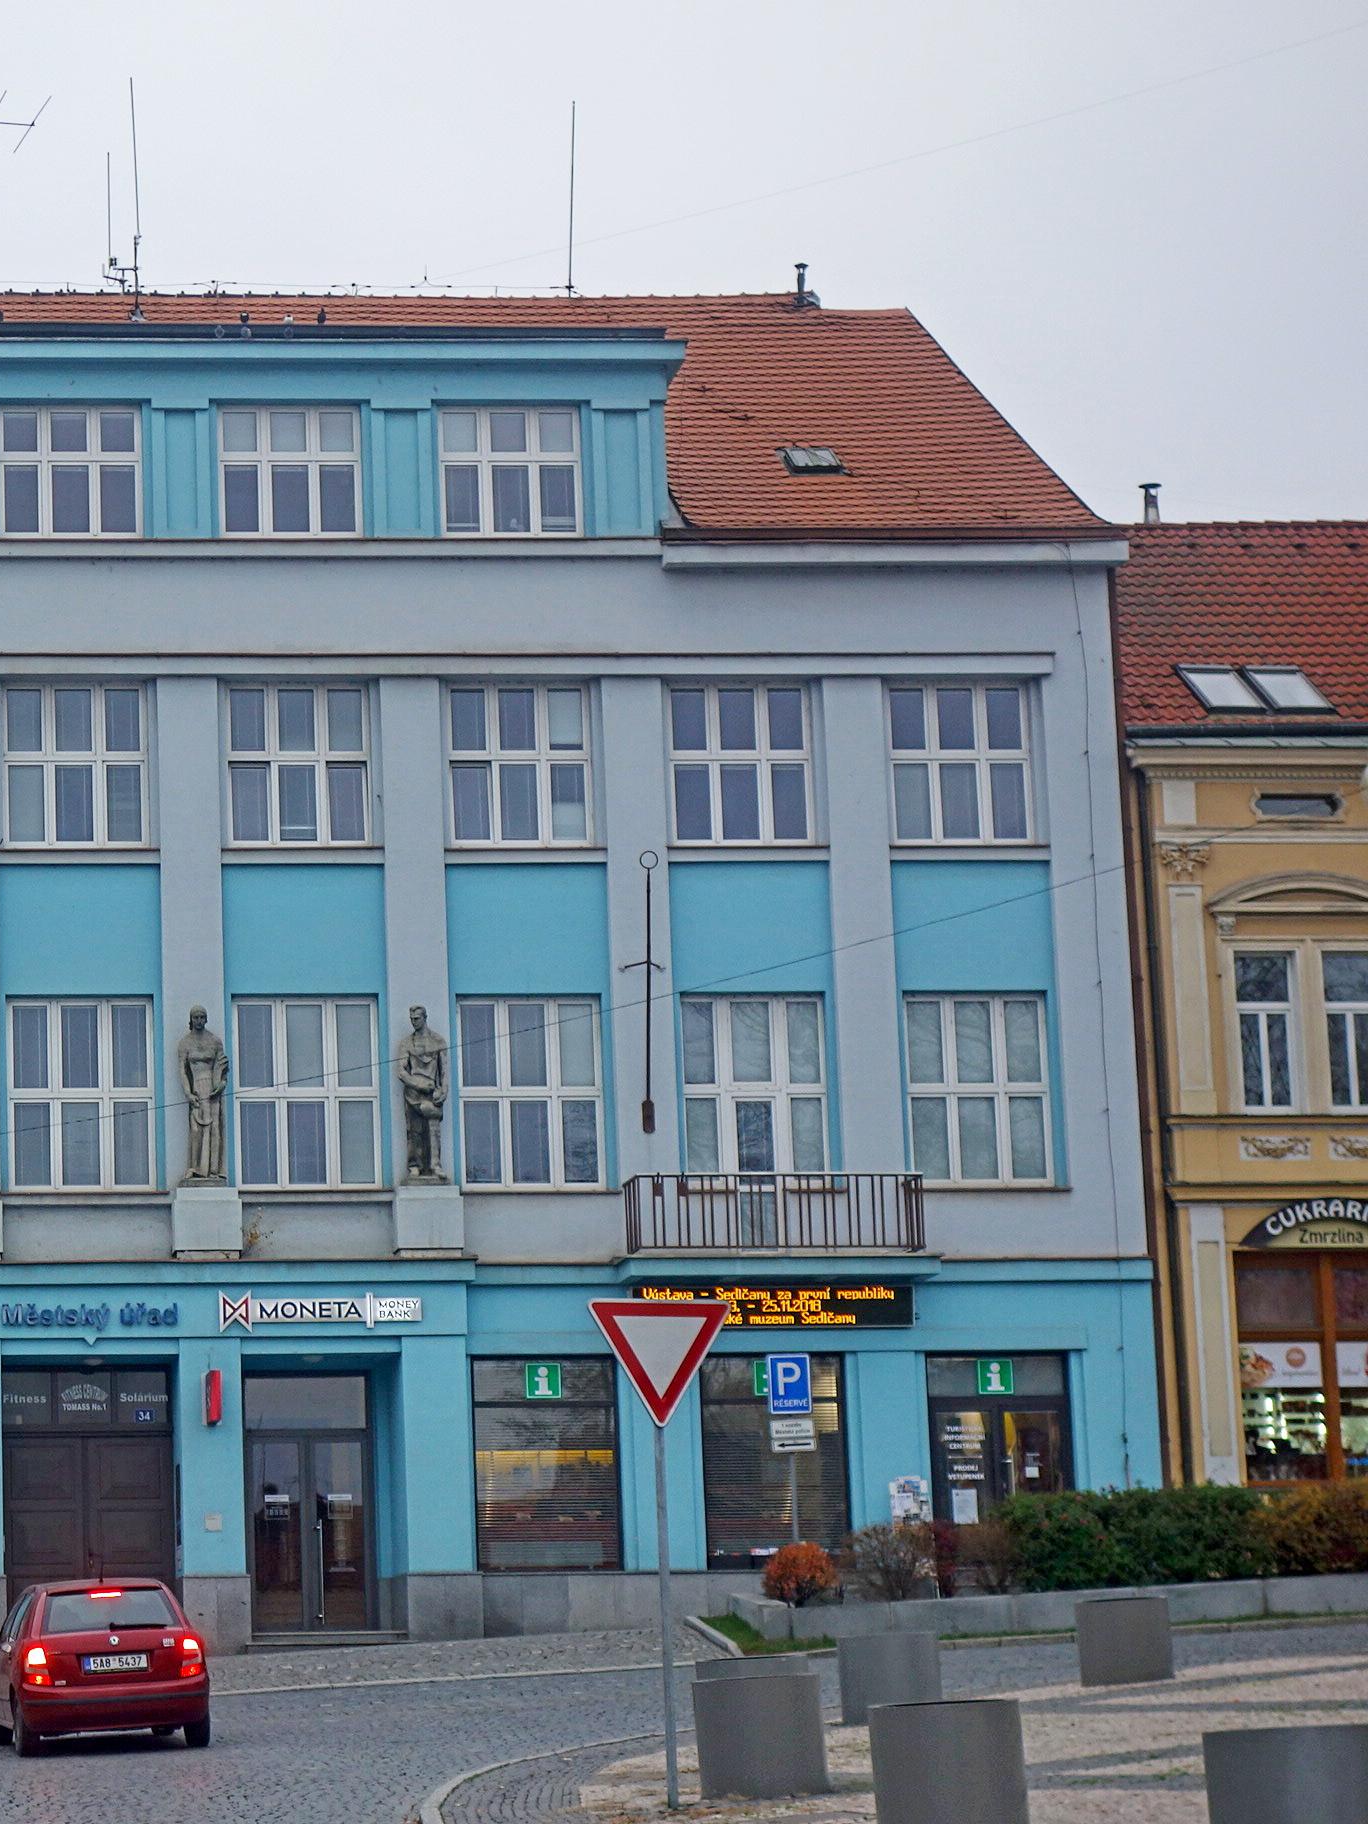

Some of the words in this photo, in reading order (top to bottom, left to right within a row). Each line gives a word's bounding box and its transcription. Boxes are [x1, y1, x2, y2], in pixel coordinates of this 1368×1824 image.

[1298, 1228, 1364, 1244] Zmrzlina
[777, 1290, 792, 1300] za
[799, 1287, 830, 1300] první
[837, 1286, 895, 1300] republiky
[259, 1301, 362, 1319] MONETA
[378, 1300, 419, 1309] MONEY
[1, 1303, 110, 1331] Městský
[119, 1302, 178, 1327] úřad
[378, 1310, 411, 1319] BANK
[750, 1315, 795, 1324] muzeum
[777, 1362, 801, 1396] P
[3, 1393, 47, 1404] Fitness
[120, 1391, 168, 1403] Solárium
[63, 1403, 90, 1411] TOMASS
[138, 1411, 151, 1421] 34
[92, 1657, 111, 1669] 5A8
[118, 1655, 142, 1668] 5437
